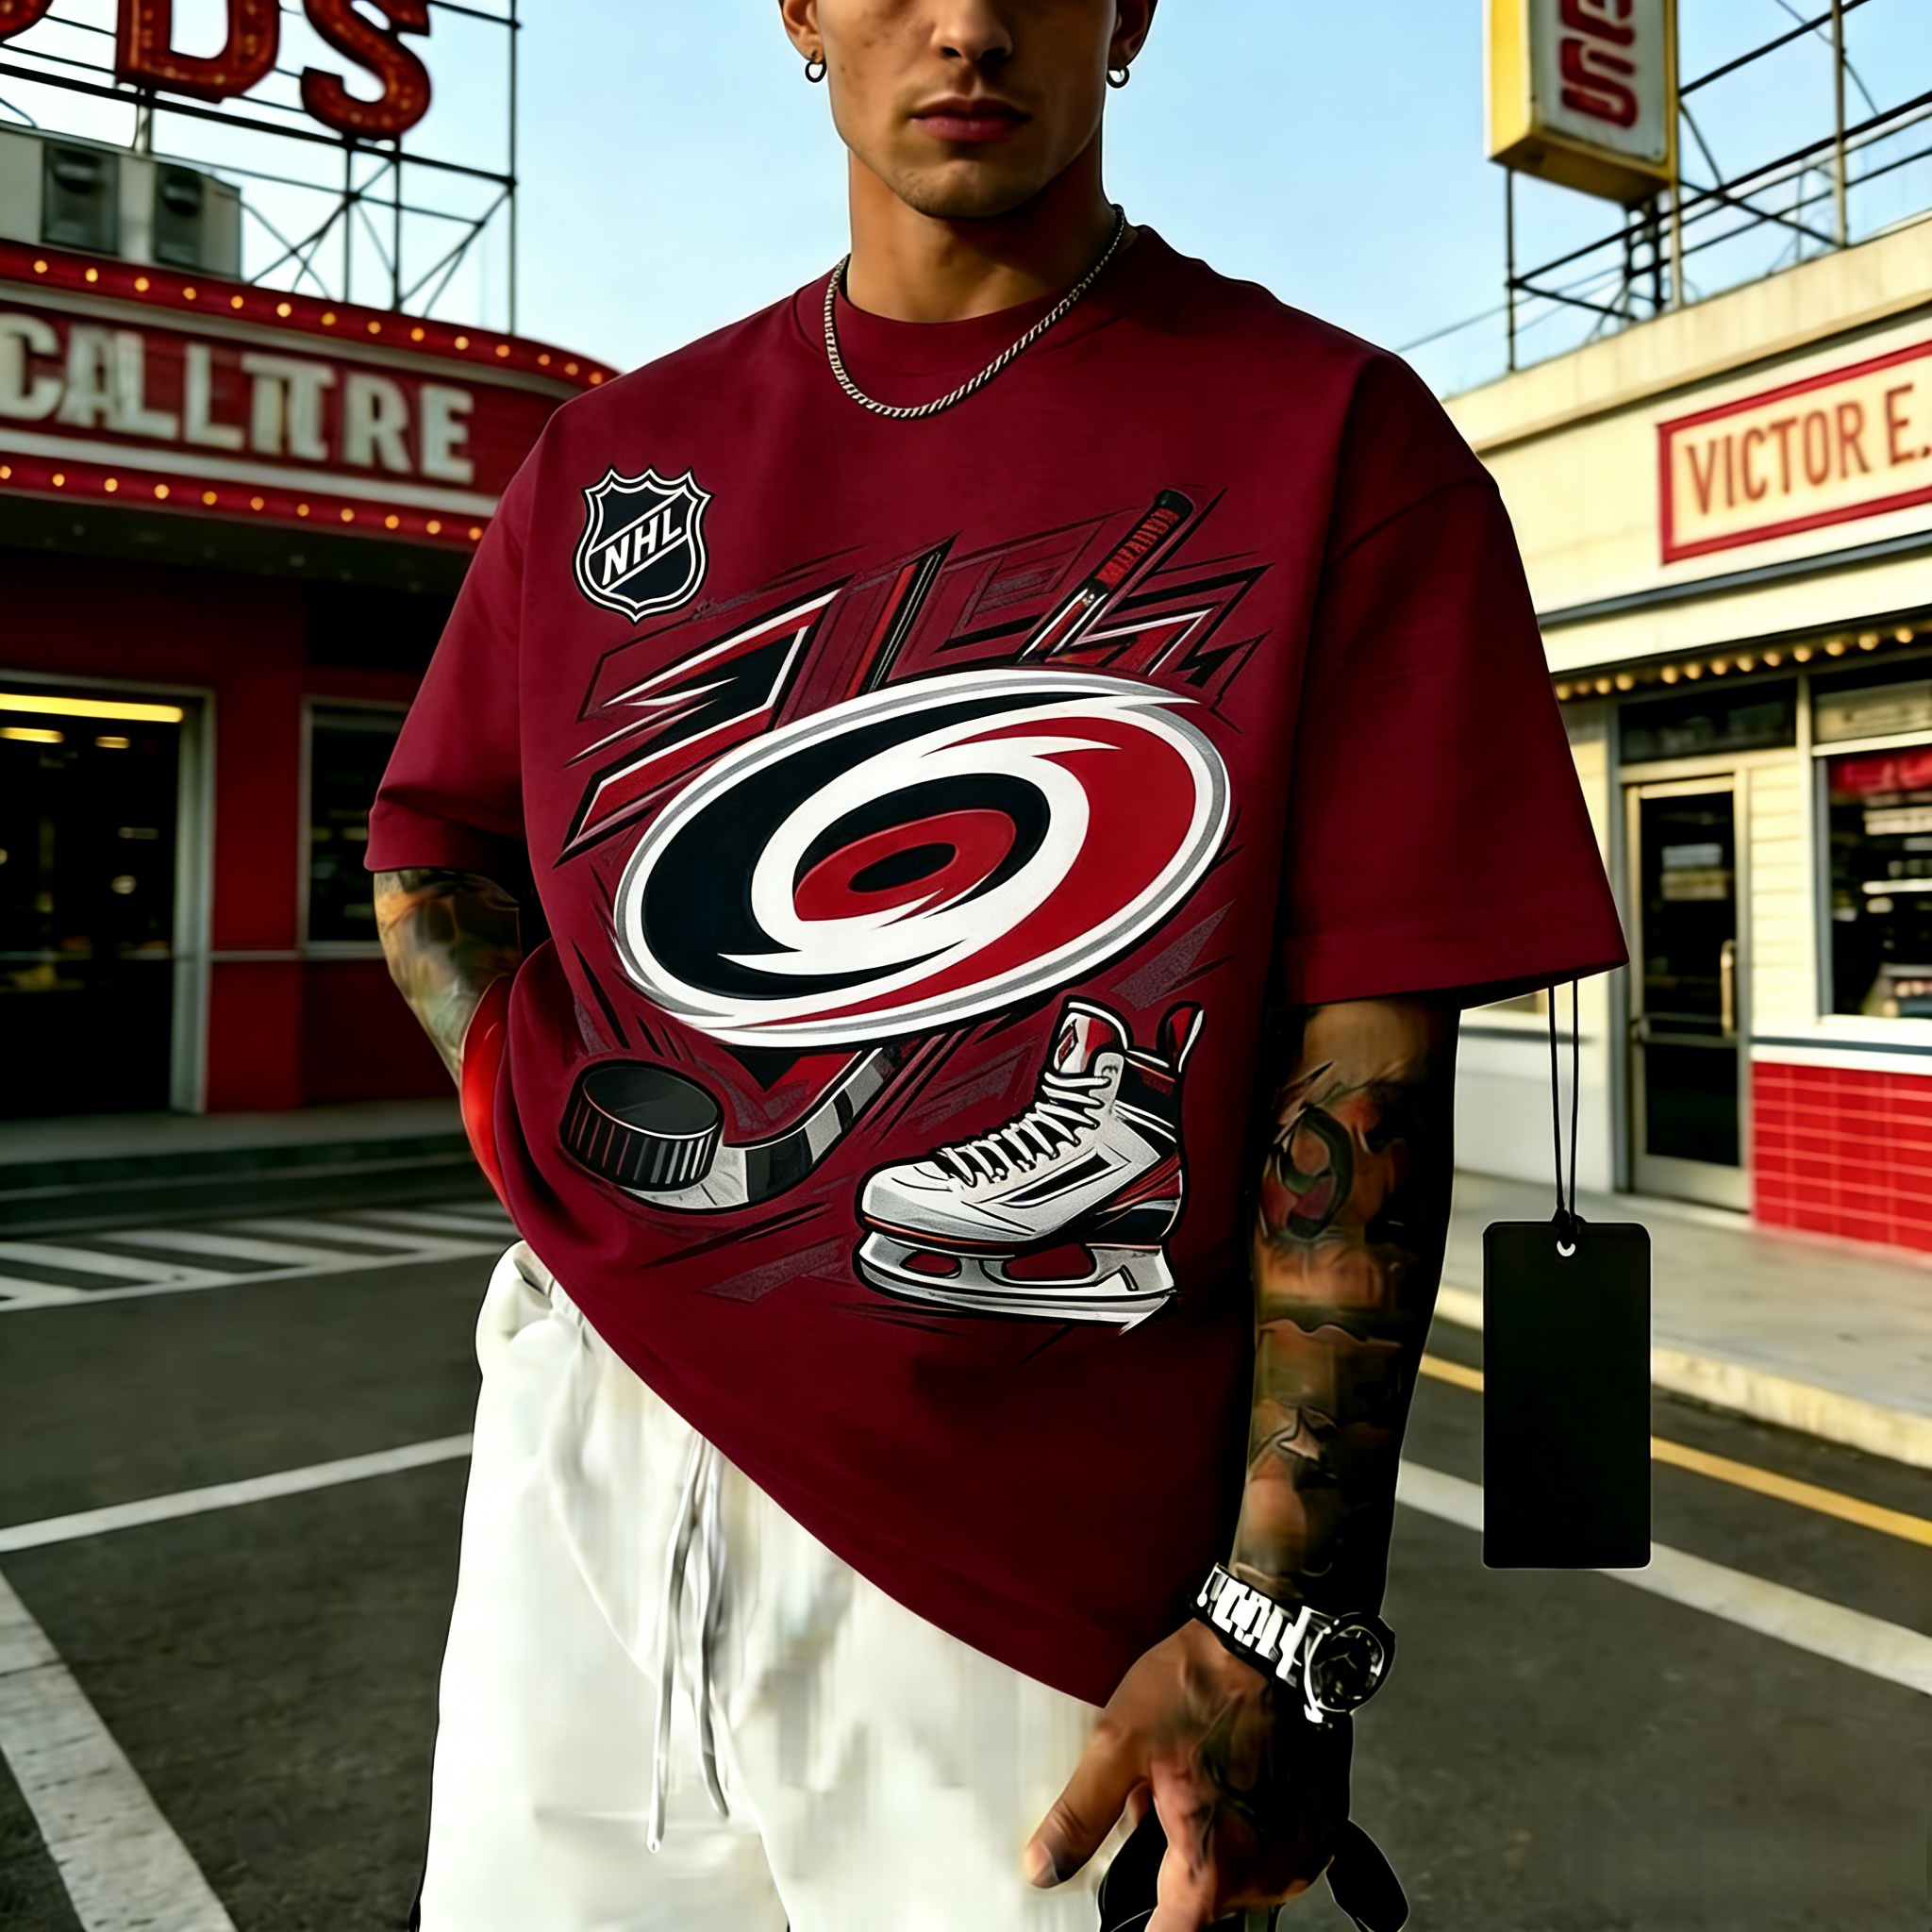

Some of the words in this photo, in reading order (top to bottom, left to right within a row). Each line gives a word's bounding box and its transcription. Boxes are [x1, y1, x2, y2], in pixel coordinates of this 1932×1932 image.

[0, 0, 431, 139] DS
[1686, 400, 1872, 516] VICTOR
[602, 508, 682, 586] NHL
